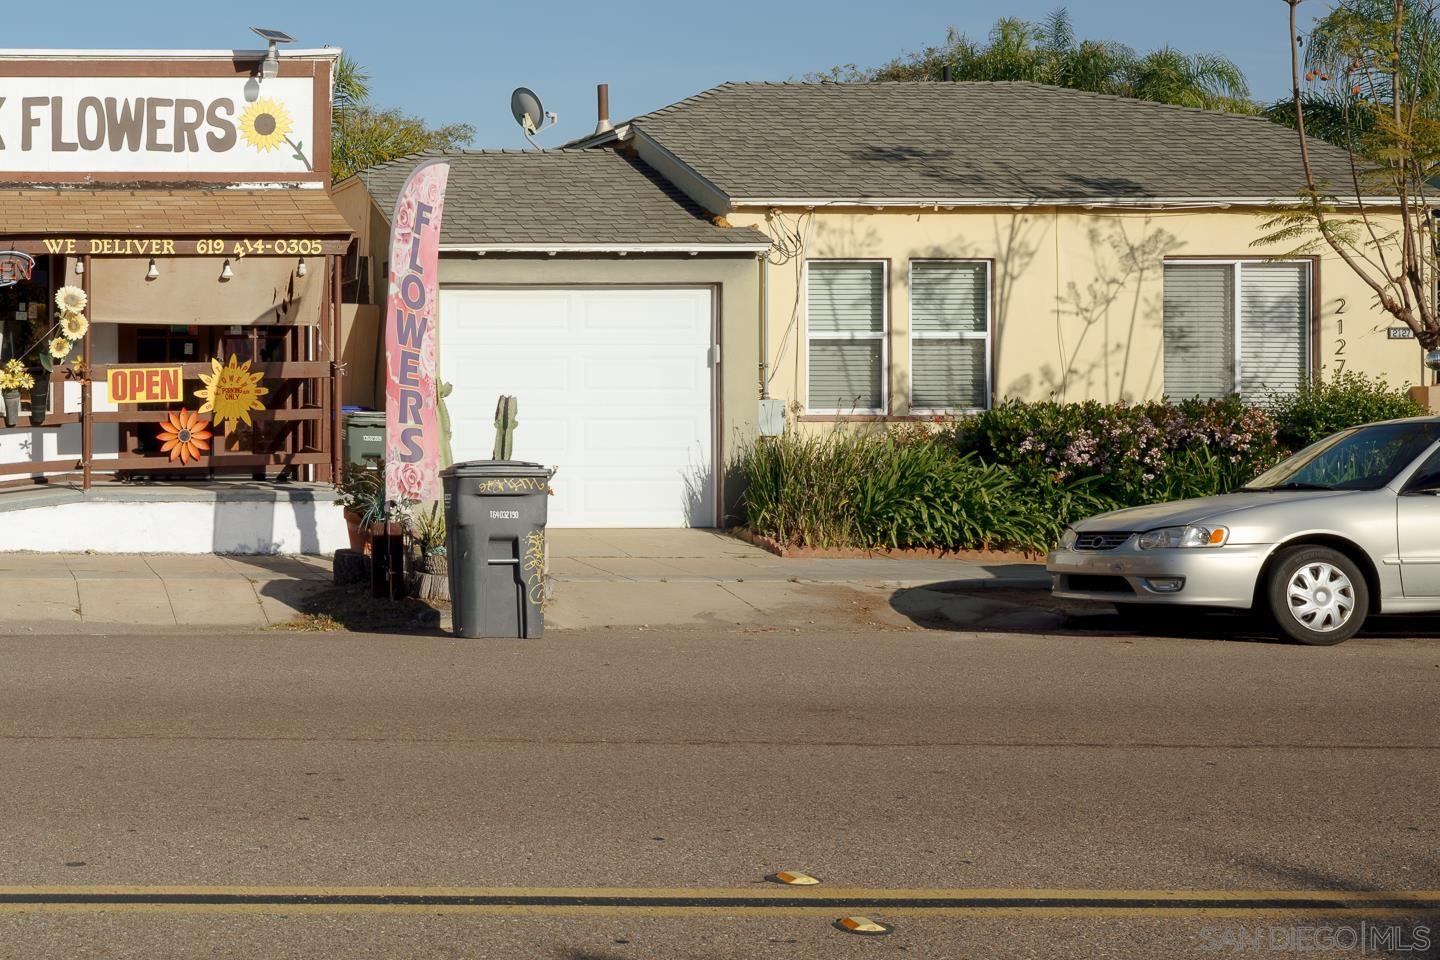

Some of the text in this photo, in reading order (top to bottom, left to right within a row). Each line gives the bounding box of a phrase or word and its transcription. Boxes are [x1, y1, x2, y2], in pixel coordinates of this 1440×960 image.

[21, 96, 237, 153] FLOWERS
[43, 238, 322, 259] WE DELIVER 619 414-0305
[396, 201, 434, 464] FLOWERS
[1334, 298, 1346, 375] 2127
[111, 369, 179, 401] OPEN
